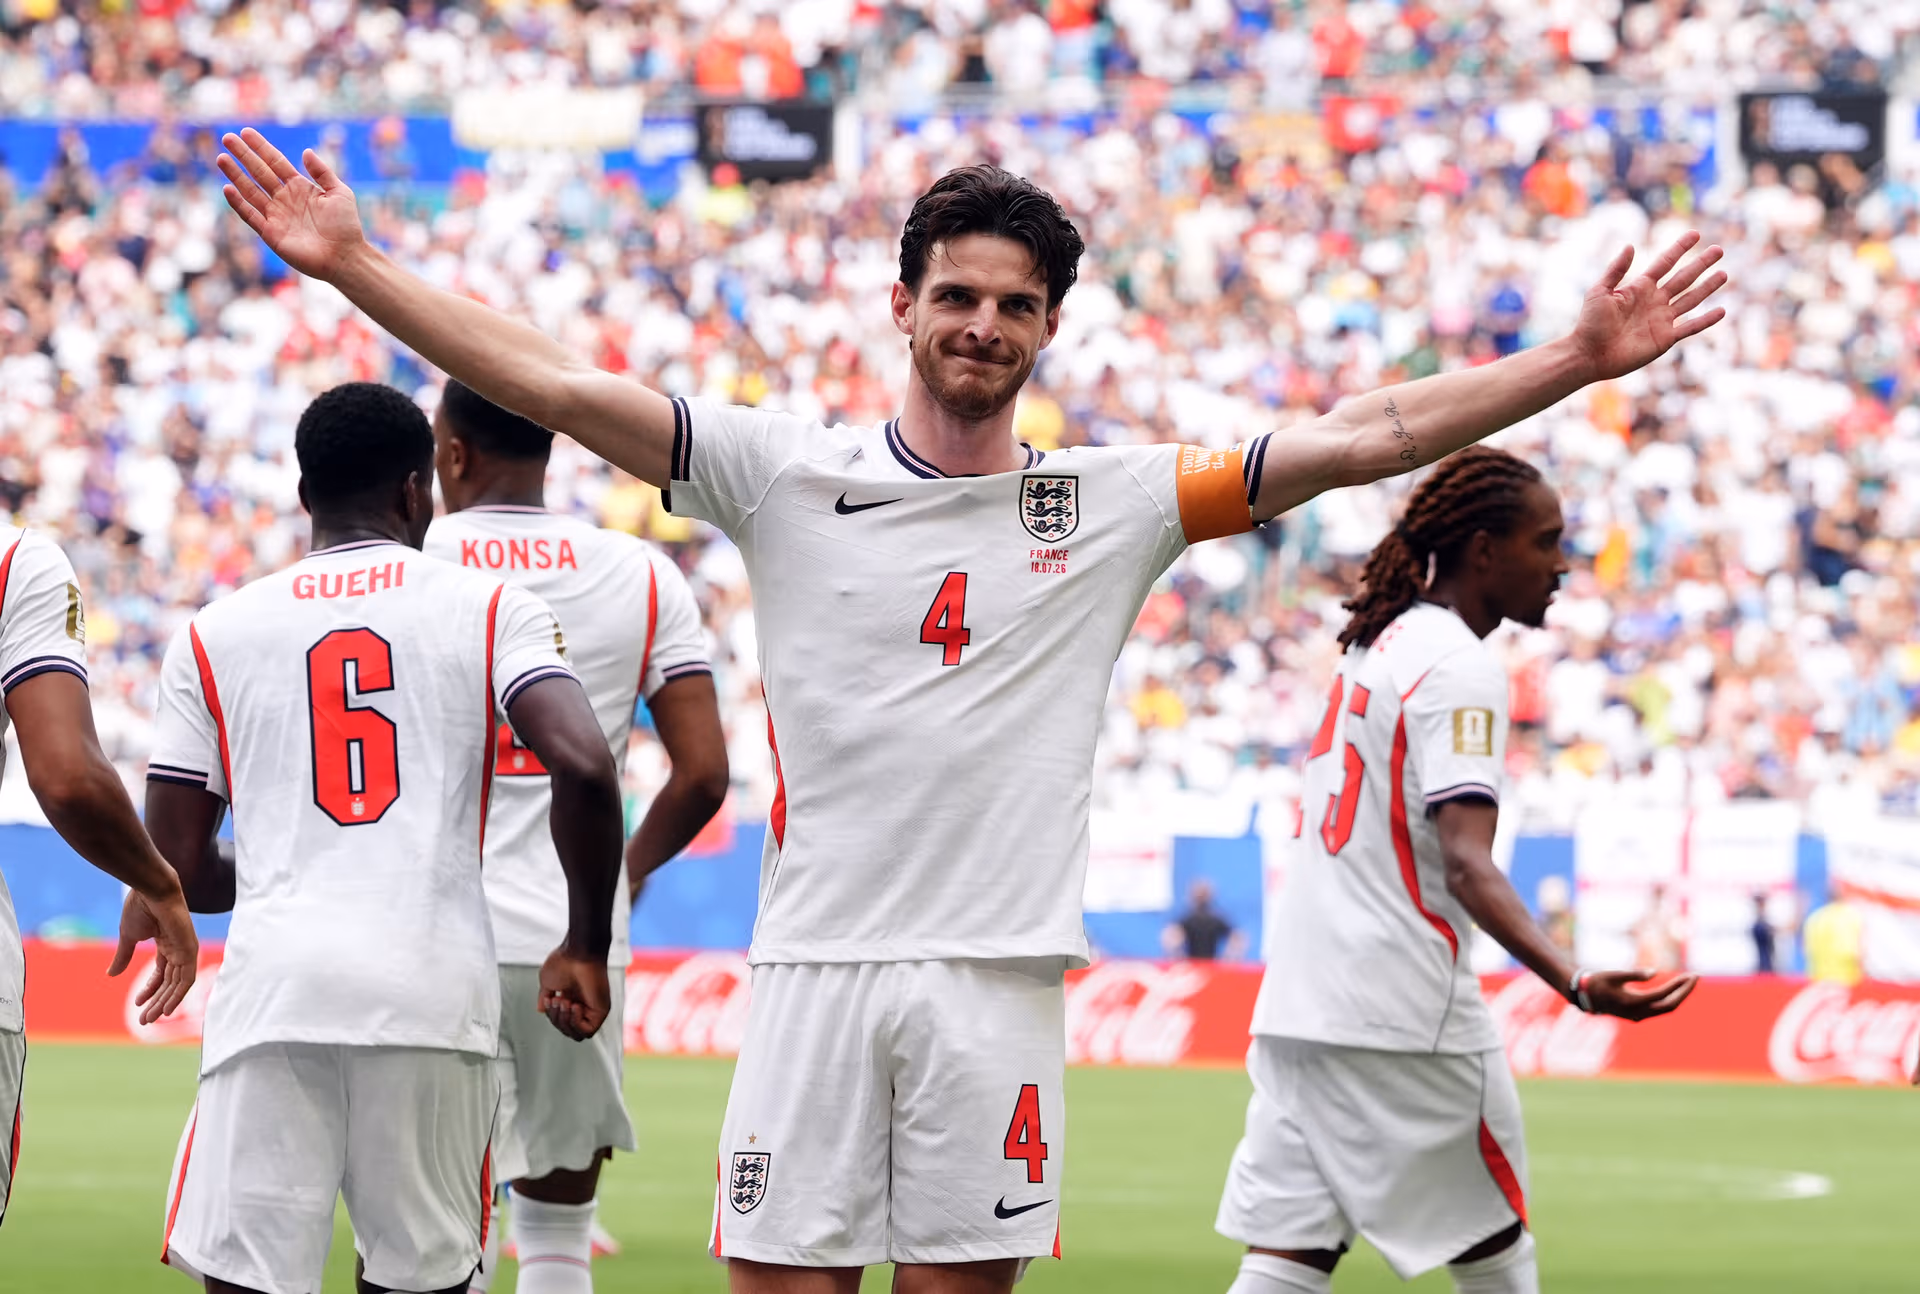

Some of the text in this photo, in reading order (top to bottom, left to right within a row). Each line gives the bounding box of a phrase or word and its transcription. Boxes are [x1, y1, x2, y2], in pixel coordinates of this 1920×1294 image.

[461, 539, 578, 570] KONSA
[1030, 549, 1069, 561] FRANCE
[1031, 561, 1067, 574] 18.07.26
[292, 561, 405, 600] GUEHI
[919, 571, 971, 667] 4
[306, 627, 401, 827] 6
[1003, 1083, 1049, 1184] 4
